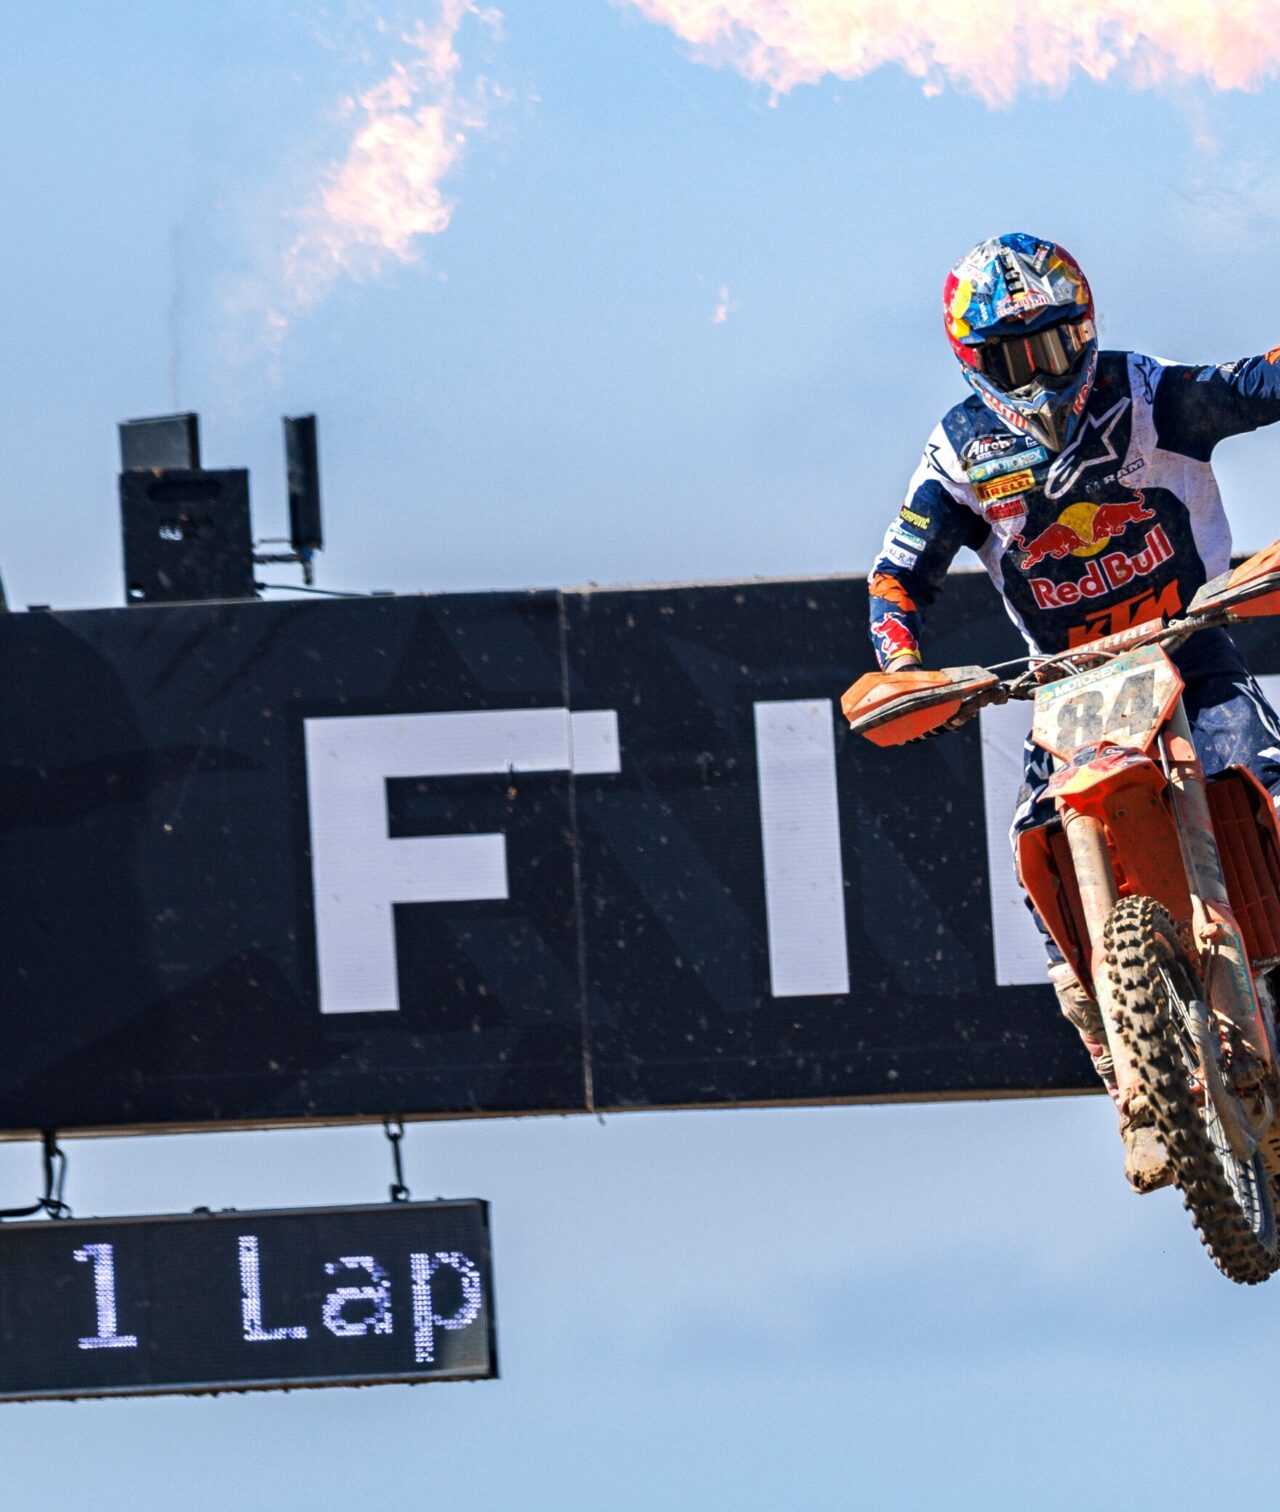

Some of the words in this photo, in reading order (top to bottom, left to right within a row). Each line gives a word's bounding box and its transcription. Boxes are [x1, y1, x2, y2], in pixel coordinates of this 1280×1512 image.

[977, 473, 1031, 500] PIRELLI
[985, 449, 1043, 476] MOTOREX
[1103, 457, 1144, 485] RAM
[1028, 560, 1109, 609] Red
[1100, 522, 1175, 590] Bull
[1068, 579, 1183, 650] KTM
[1054, 664, 1121, 698] MOTOREX
[1056, 669, 1160, 752] 84
[73, 1242, 138, 1349] 1
[237, 1235, 483, 1364] Lap
